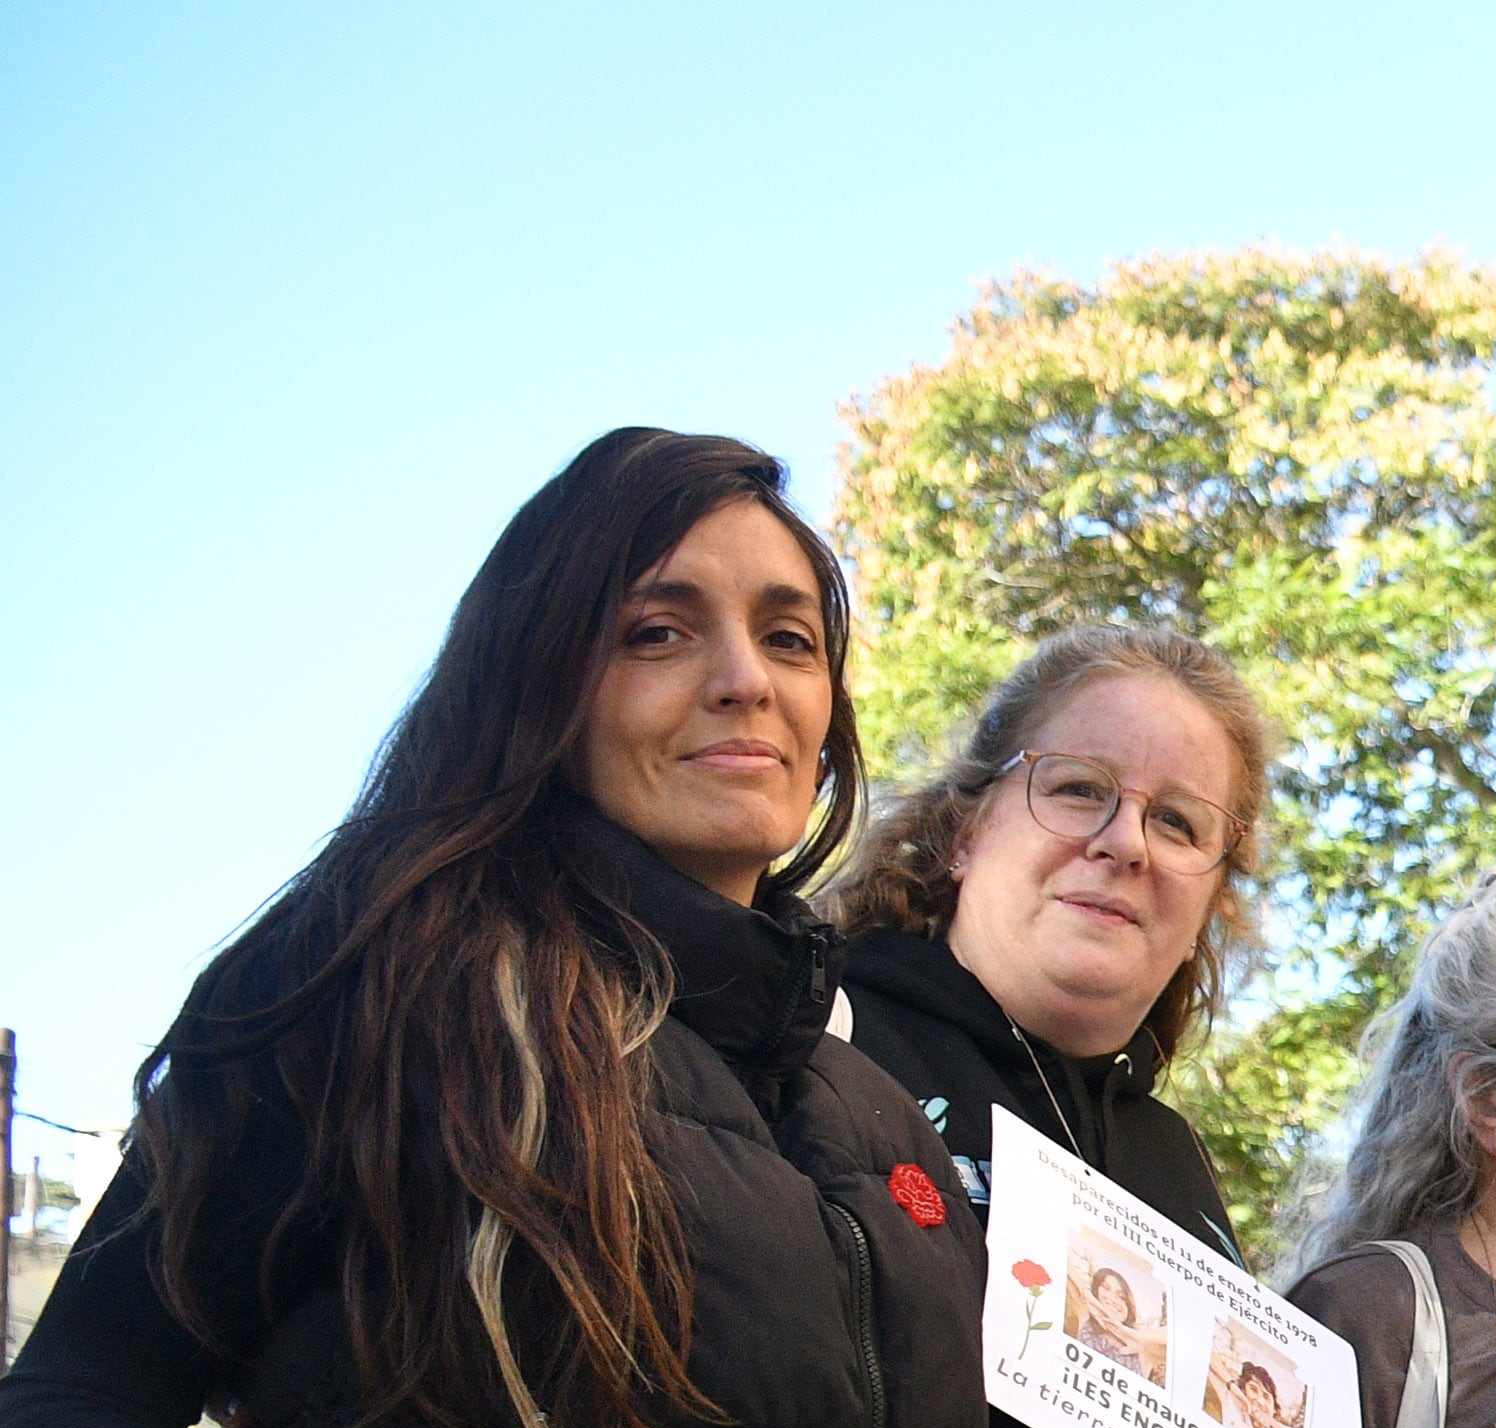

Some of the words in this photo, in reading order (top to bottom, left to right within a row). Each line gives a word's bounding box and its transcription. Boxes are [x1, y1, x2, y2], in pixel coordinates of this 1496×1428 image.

[1039, 1150, 1158, 1239] Desaparecidos
[1162, 1237, 1175, 1251] el
[1180, 1248, 1192, 1262] 11
[1197, 1260, 1214, 1277] de
[1218, 1274, 1261, 1309] enero
[1265, 1306, 1281, 1322] de
[1286, 1320, 1318, 1347] 1978
[1073, 1193, 1099, 1216] por
[1104, 1215, 1118, 1230] el
[1122, 1224, 1141, 1246] III
[1145, 1241, 1202, 1287] Cuerpo
[1207, 1284, 1225, 1301] de
[1230, 1297, 1289, 1345] Ejército
[997, 1358, 1028, 1387] La
[1063, 1367, 1111, 1409] ¡LES
[1066, 1343, 1093, 1369] 07
[1101, 1368, 1129, 1395] de
